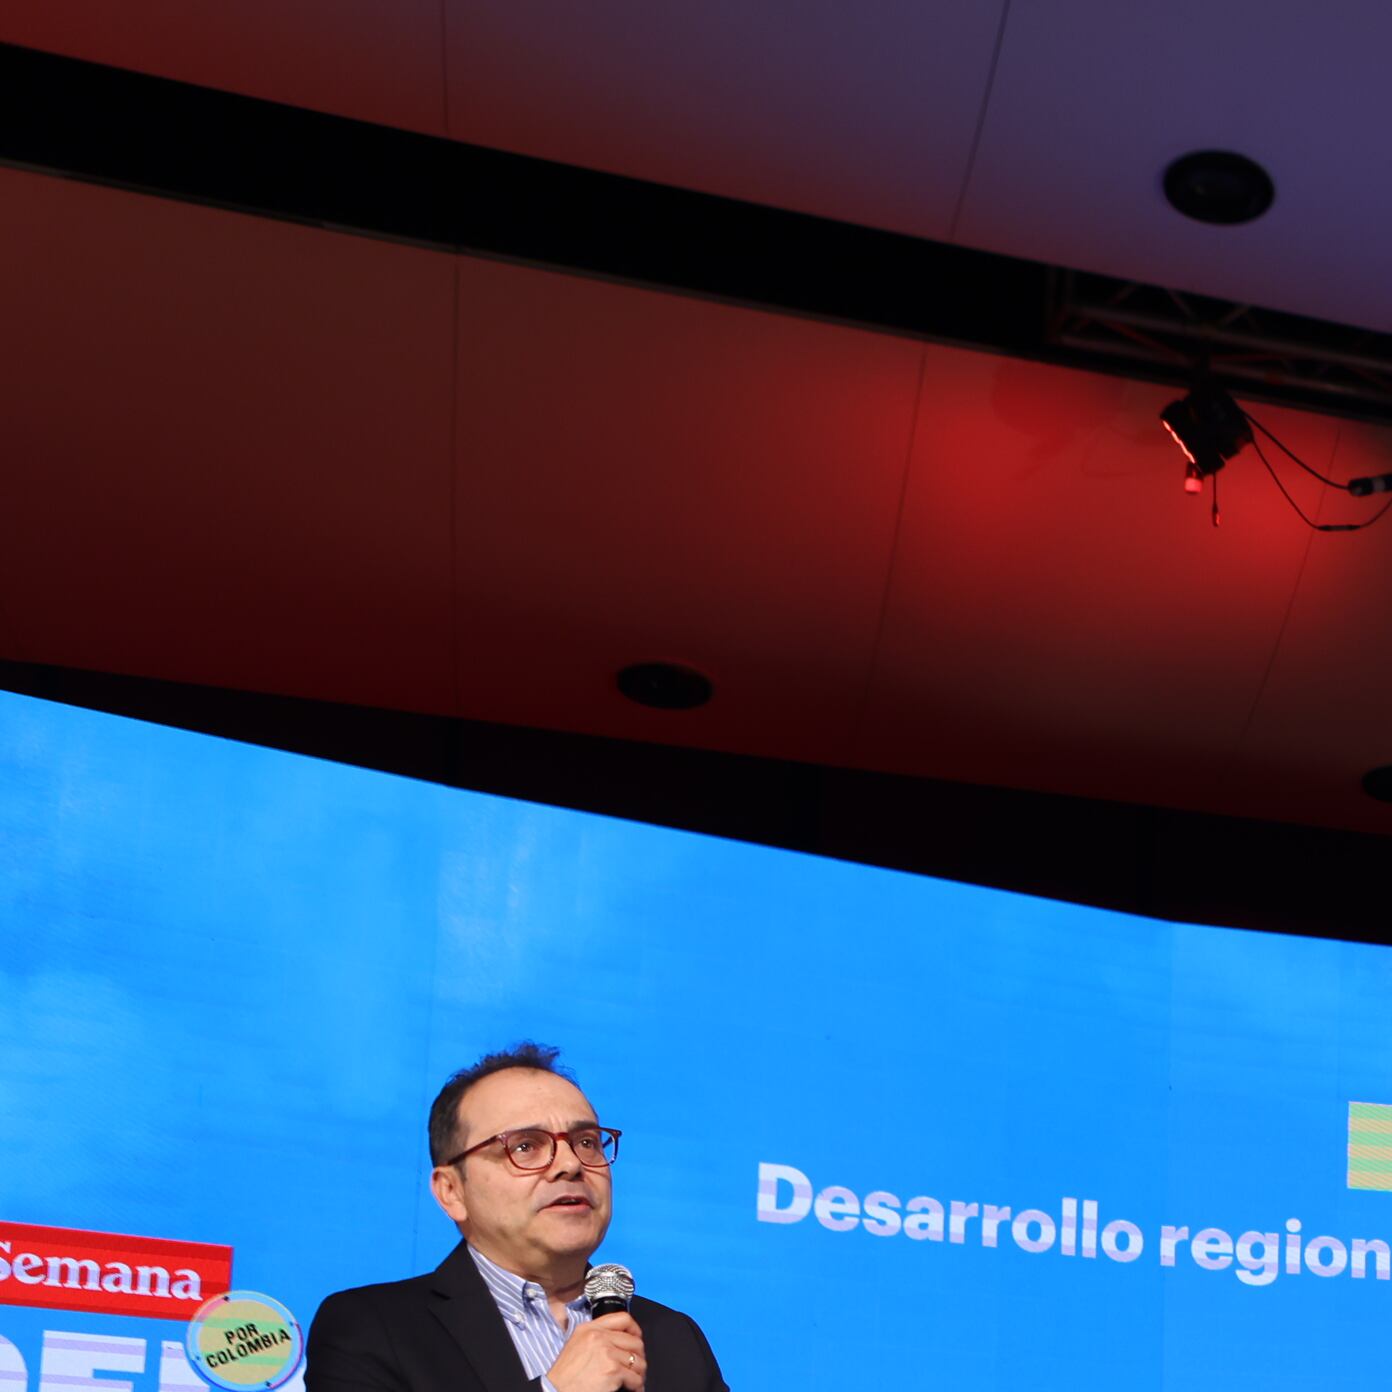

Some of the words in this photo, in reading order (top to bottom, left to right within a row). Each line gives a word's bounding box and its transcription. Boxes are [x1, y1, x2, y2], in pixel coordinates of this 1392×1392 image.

[757, 1162, 1144, 1264] Desarrollo
[206, 1328, 292, 1369] COLOMBIA
[224, 1323, 259, 1346] POR
